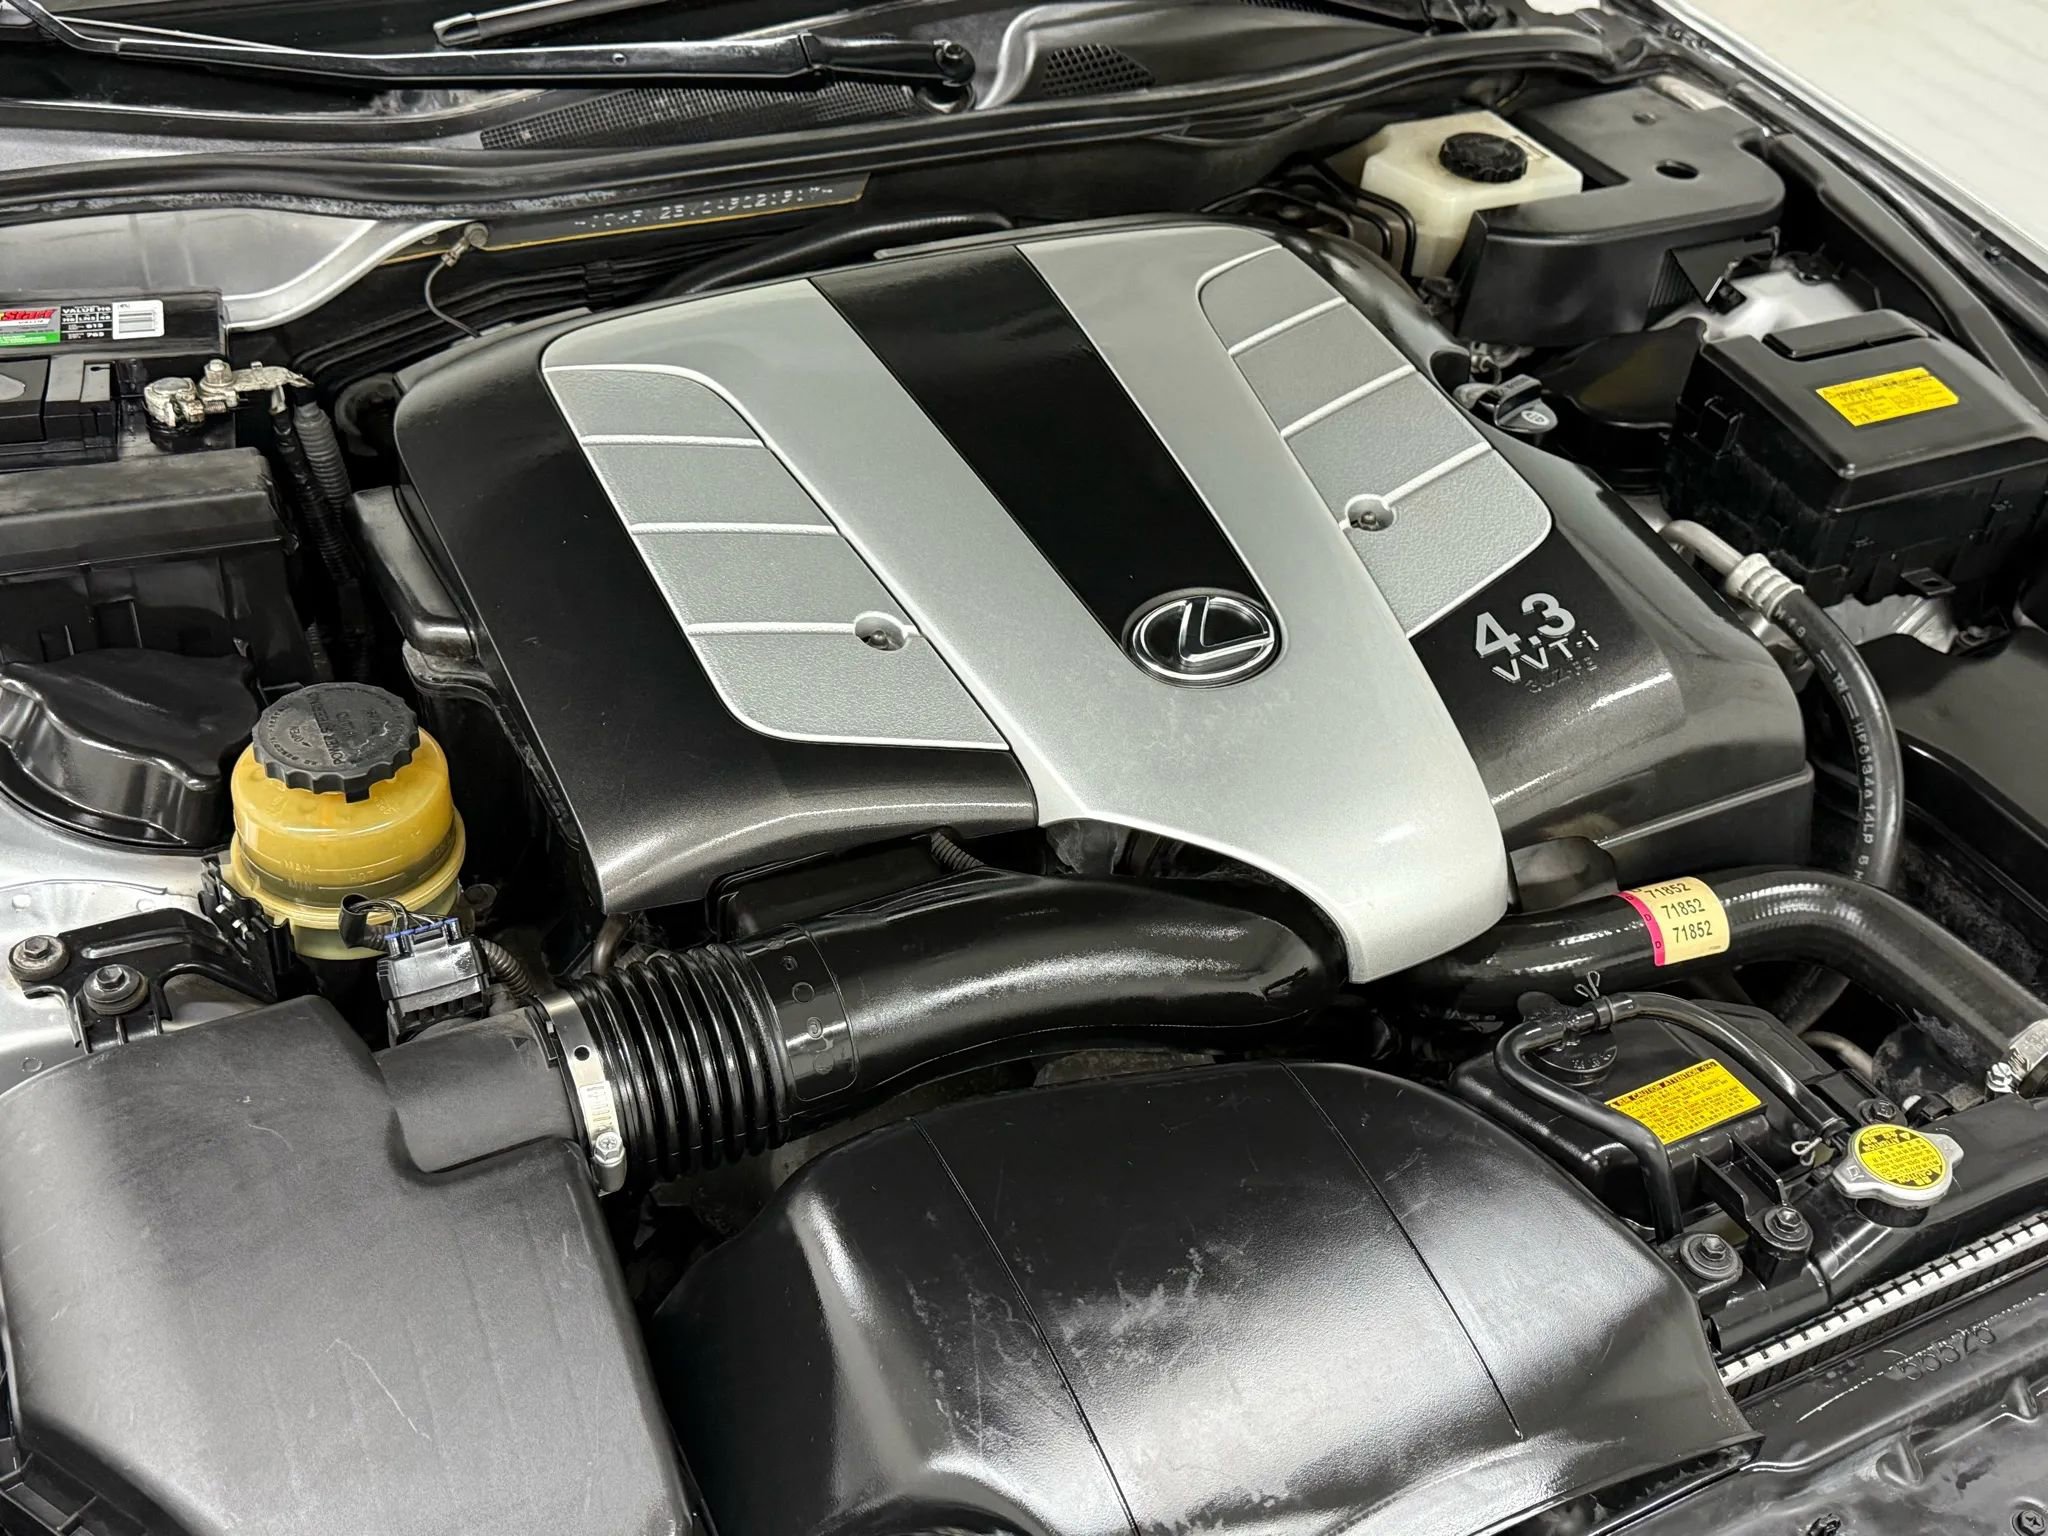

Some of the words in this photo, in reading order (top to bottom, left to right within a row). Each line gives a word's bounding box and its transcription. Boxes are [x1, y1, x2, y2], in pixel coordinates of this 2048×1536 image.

[1475, 592, 1576, 659] 4.3
[1491, 629, 1600, 684] VVT-i
[1643, 882, 1692, 899] 71852
[1660, 898, 1706, 920] 71852
[1672, 919, 1714, 944] 71852
